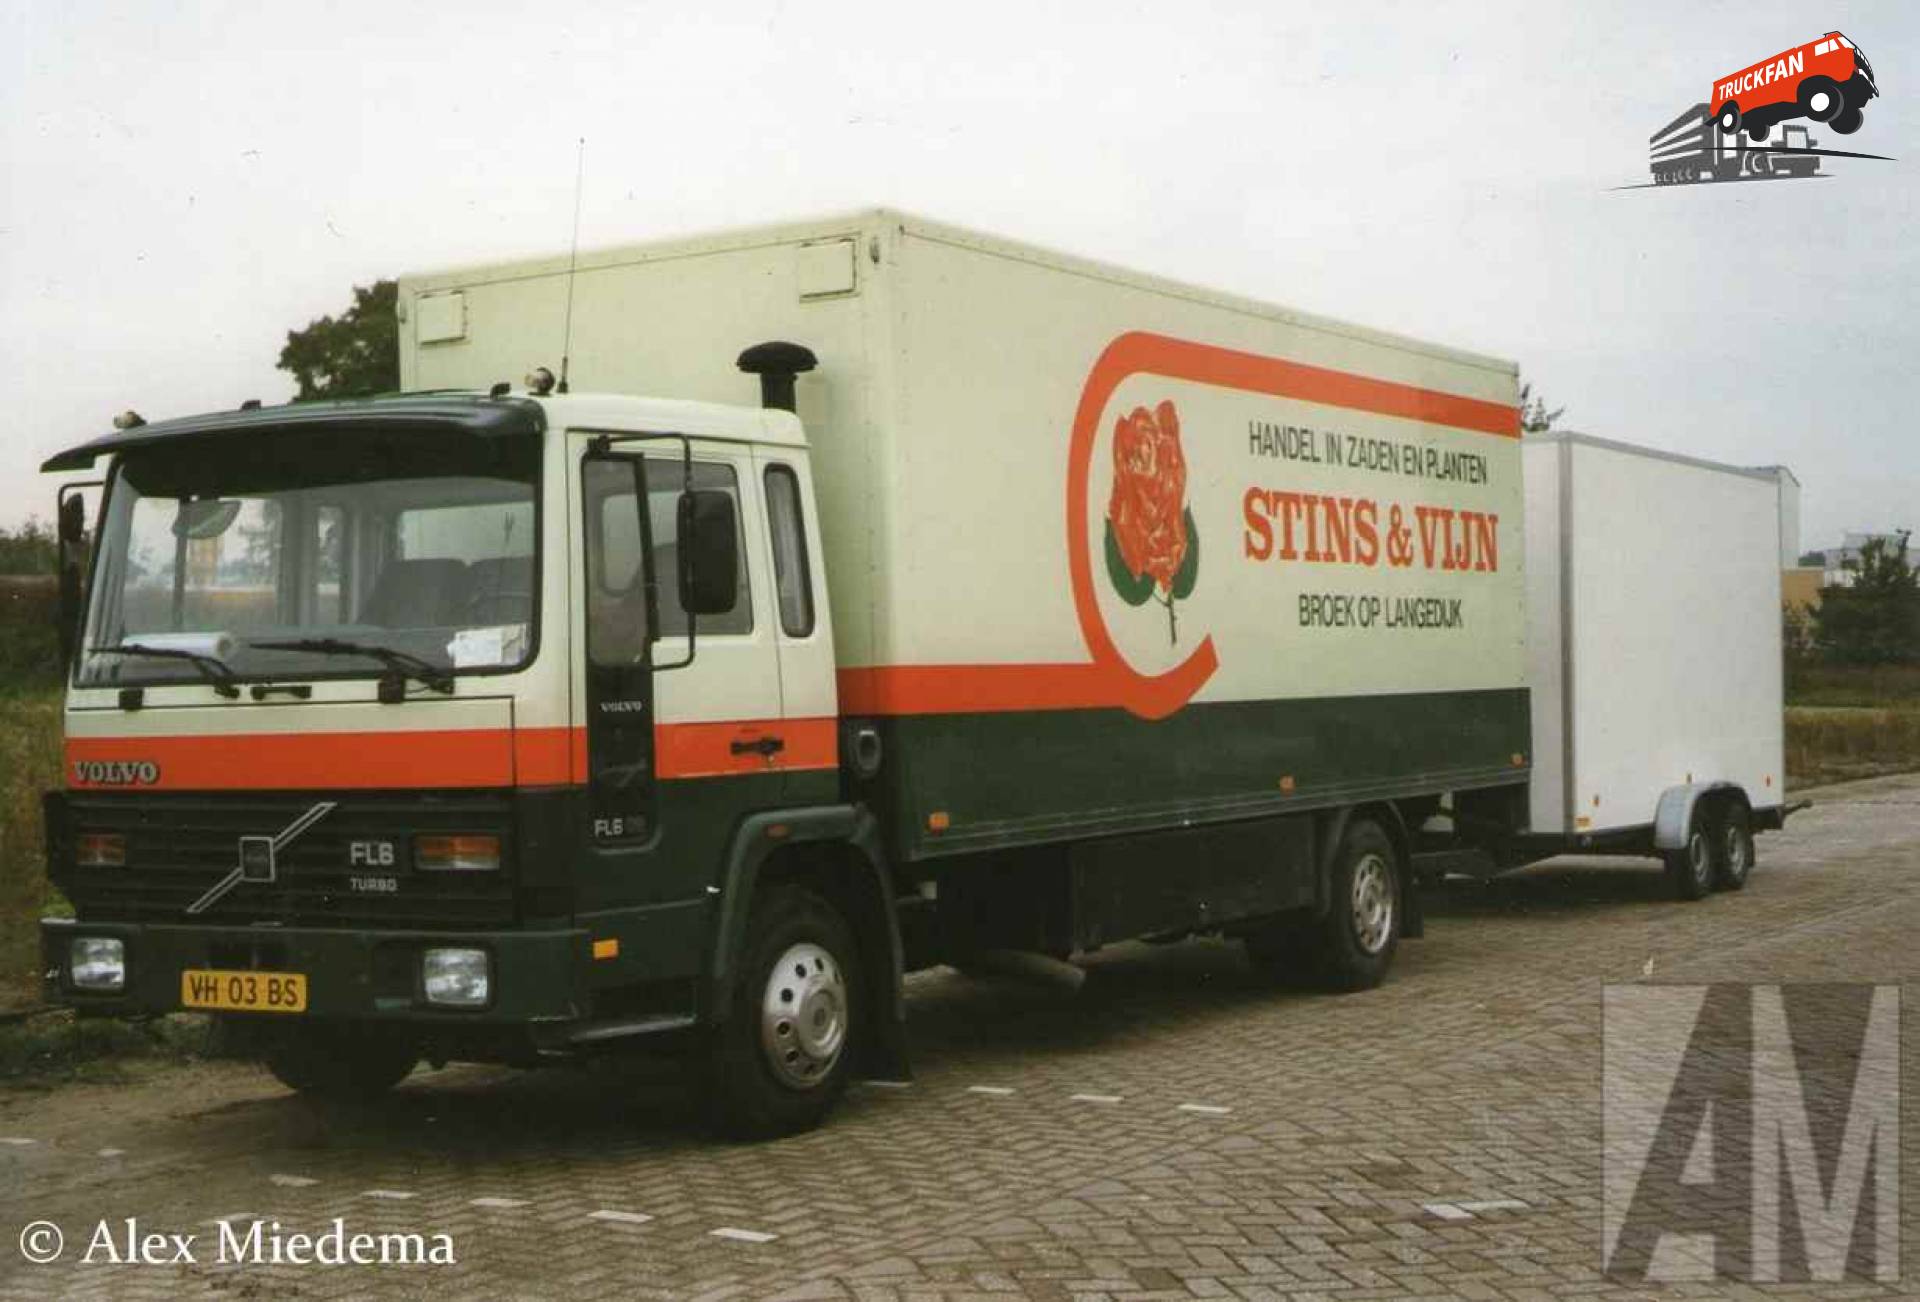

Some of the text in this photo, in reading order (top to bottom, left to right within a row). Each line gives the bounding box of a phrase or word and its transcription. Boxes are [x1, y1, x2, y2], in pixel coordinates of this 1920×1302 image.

[1249, 421, 1488, 485] HANDEL IN ZADEN EN PLANTEN
[1243, 486, 1498, 573] STINS & VIJN
[1299, 594, 1355, 628] BROEK
[1359, 597, 1381, 628] OP
[601, 701, 643, 713] VOLVO
[73, 760, 160, 785] VOLVO
[594, 818, 624, 837] FL6
[350, 841, 394, 866] FL6
[350, 877, 397, 892] TURBO
[189, 974, 299, 1006] VH 03 BS
